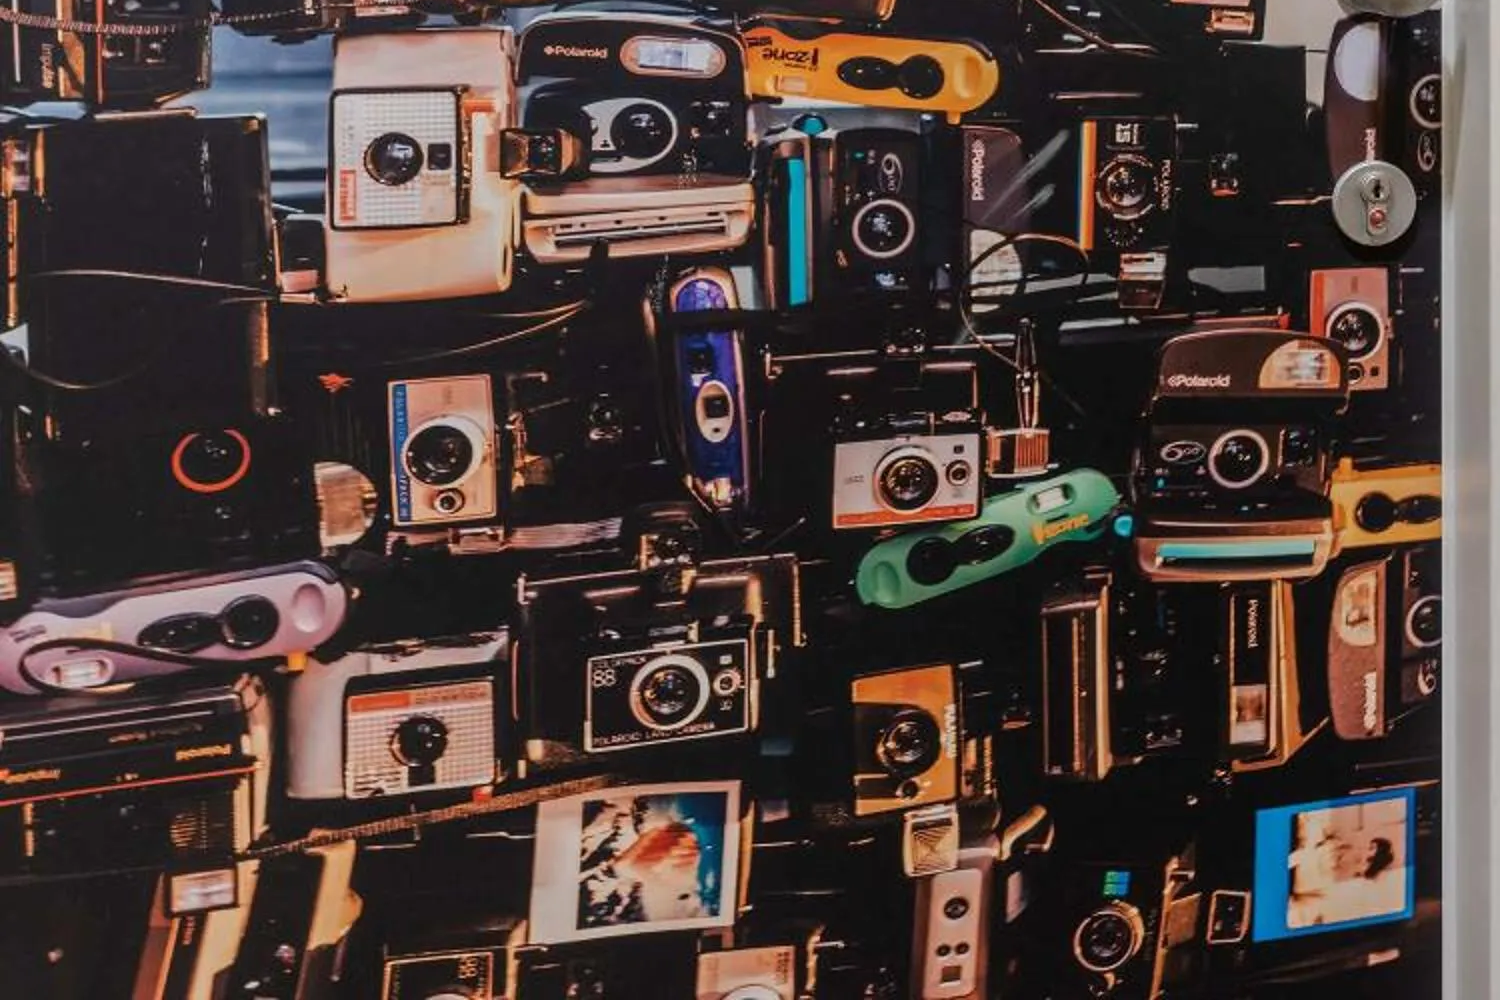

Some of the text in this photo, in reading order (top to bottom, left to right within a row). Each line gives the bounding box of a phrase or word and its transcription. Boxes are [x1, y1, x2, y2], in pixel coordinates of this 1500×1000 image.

[554, 45, 608, 59] Polaroid
[971, 150, 985, 201] Polaroid
[1176, 375, 1231, 387] Polaroid
[593, 668, 616, 687] 88
